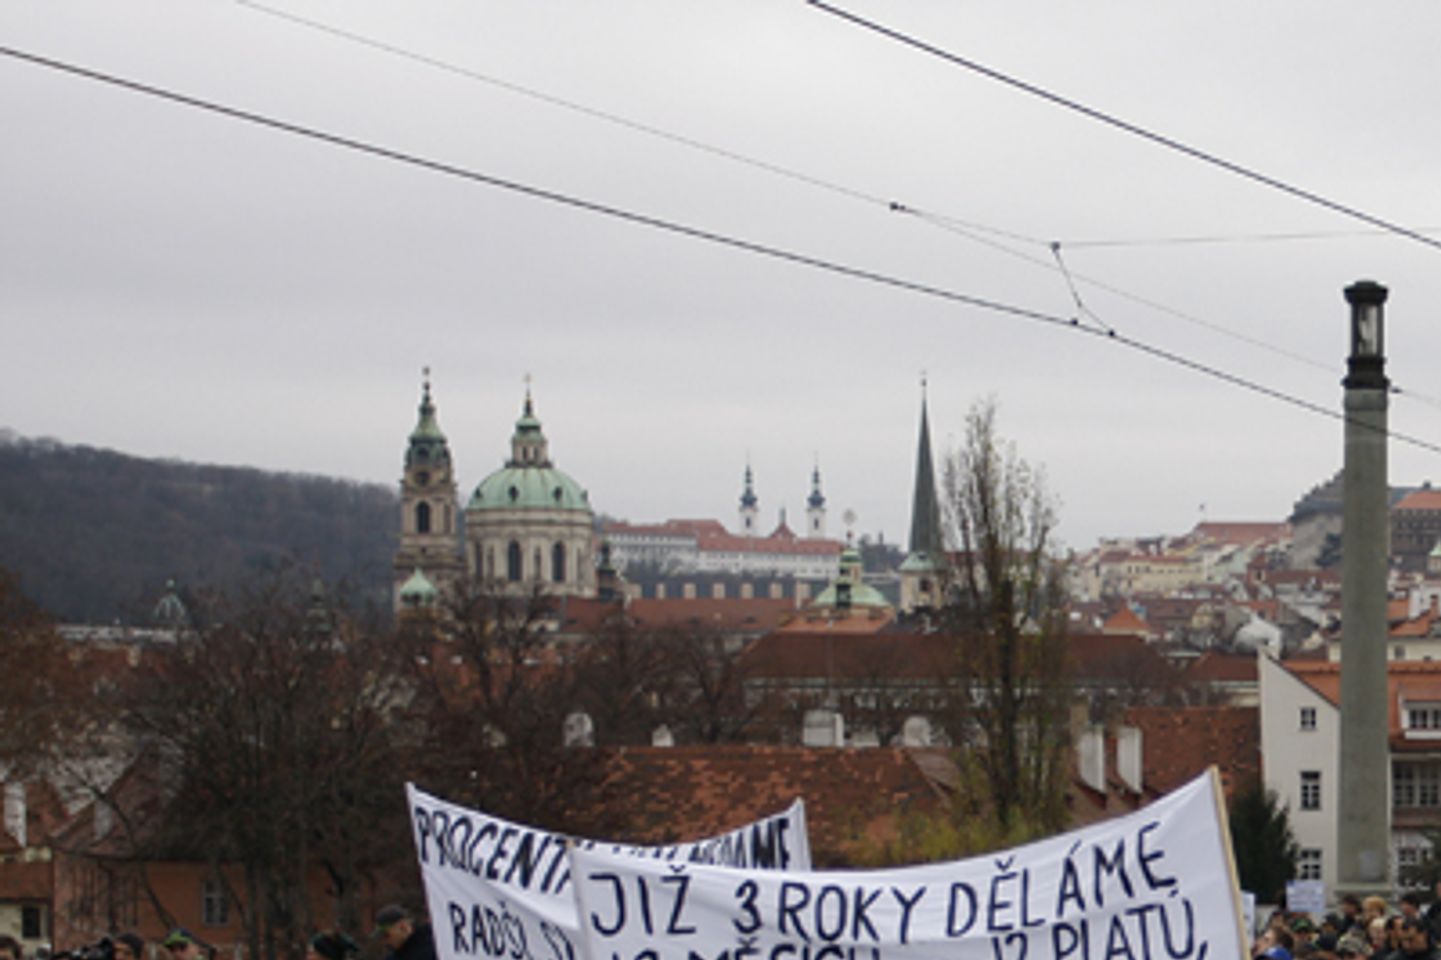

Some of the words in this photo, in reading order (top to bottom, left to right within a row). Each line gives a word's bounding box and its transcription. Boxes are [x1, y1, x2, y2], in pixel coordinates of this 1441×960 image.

[588, 864, 698, 936] JIŽ
[733, 878, 764, 935] 3
[777, 881, 927, 945] ROKY
[946, 821, 1178, 938] DĚLÁME
